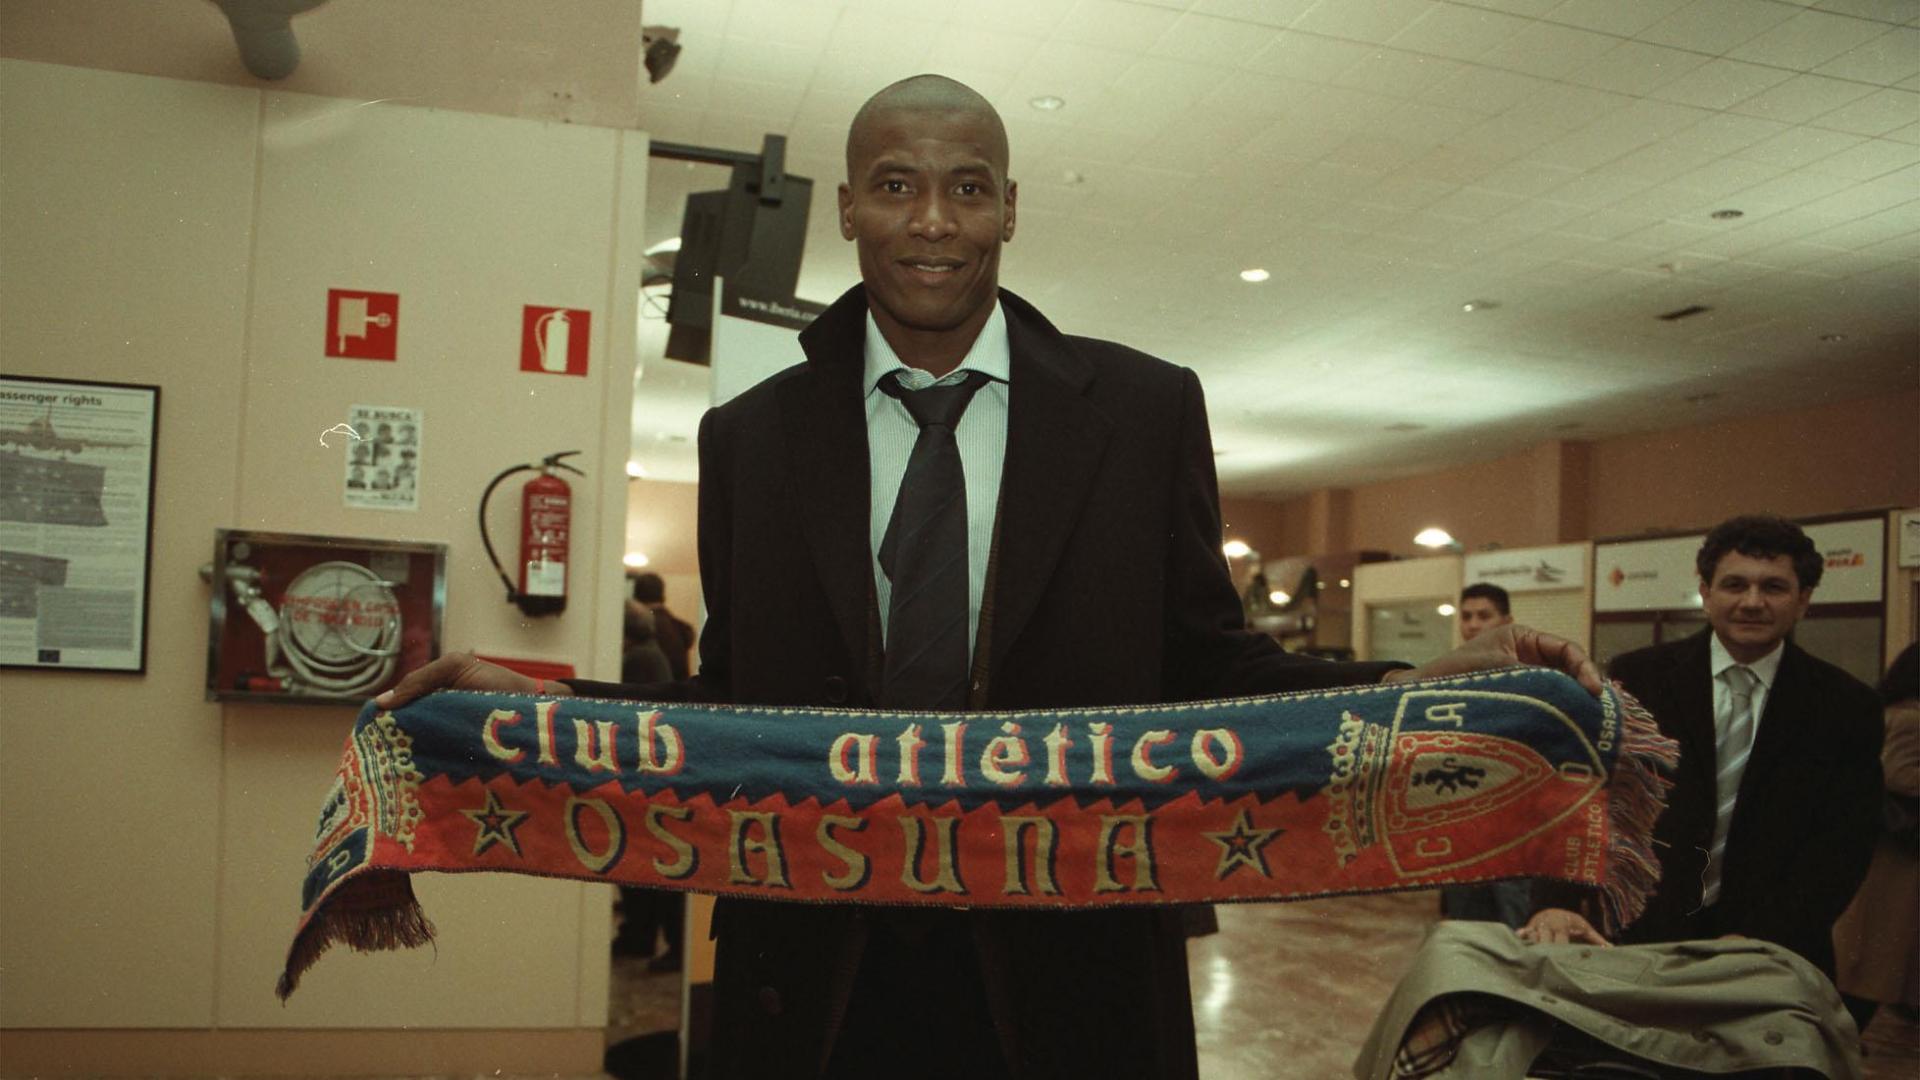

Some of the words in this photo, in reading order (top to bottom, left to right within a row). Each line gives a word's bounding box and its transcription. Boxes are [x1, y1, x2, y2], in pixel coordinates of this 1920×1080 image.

[63, 394, 102, 406] rights
[482, 700, 686, 776] club
[564, 796, 1166, 896] OSASUNA
[1565, 836, 1582, 880] CLUB
